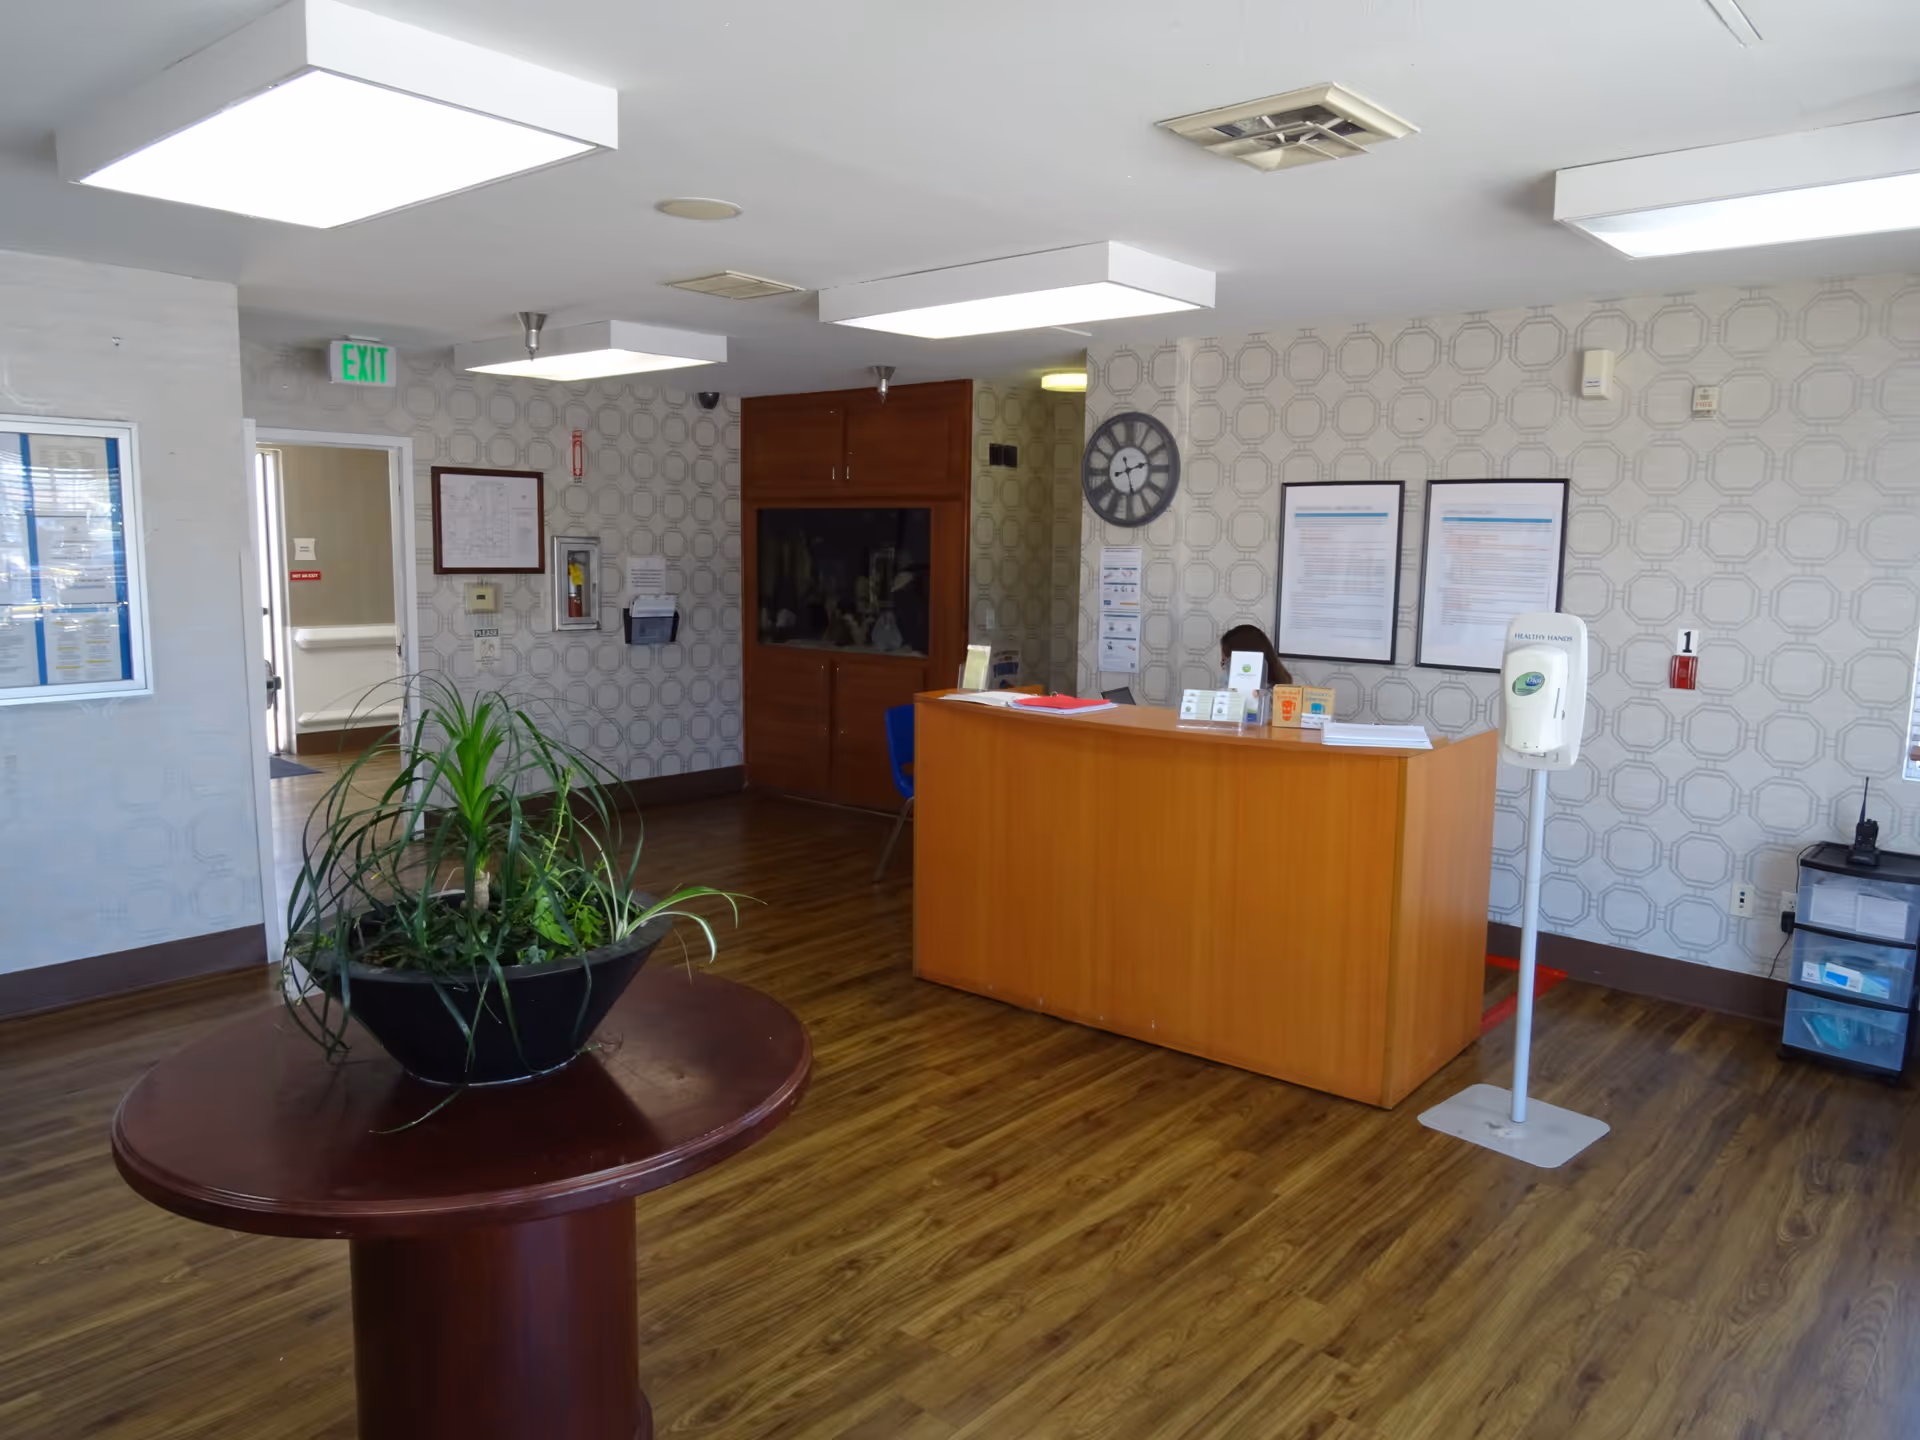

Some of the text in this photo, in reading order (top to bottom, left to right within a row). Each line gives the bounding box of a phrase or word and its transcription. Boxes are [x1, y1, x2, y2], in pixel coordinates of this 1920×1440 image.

[342, 343, 388, 384] EXIT
[475, 629, 498, 637] PLEASE
[1514, 632, 1574, 642] HEALTHY HANDS
[1682, 631, 1692, 653] 1
